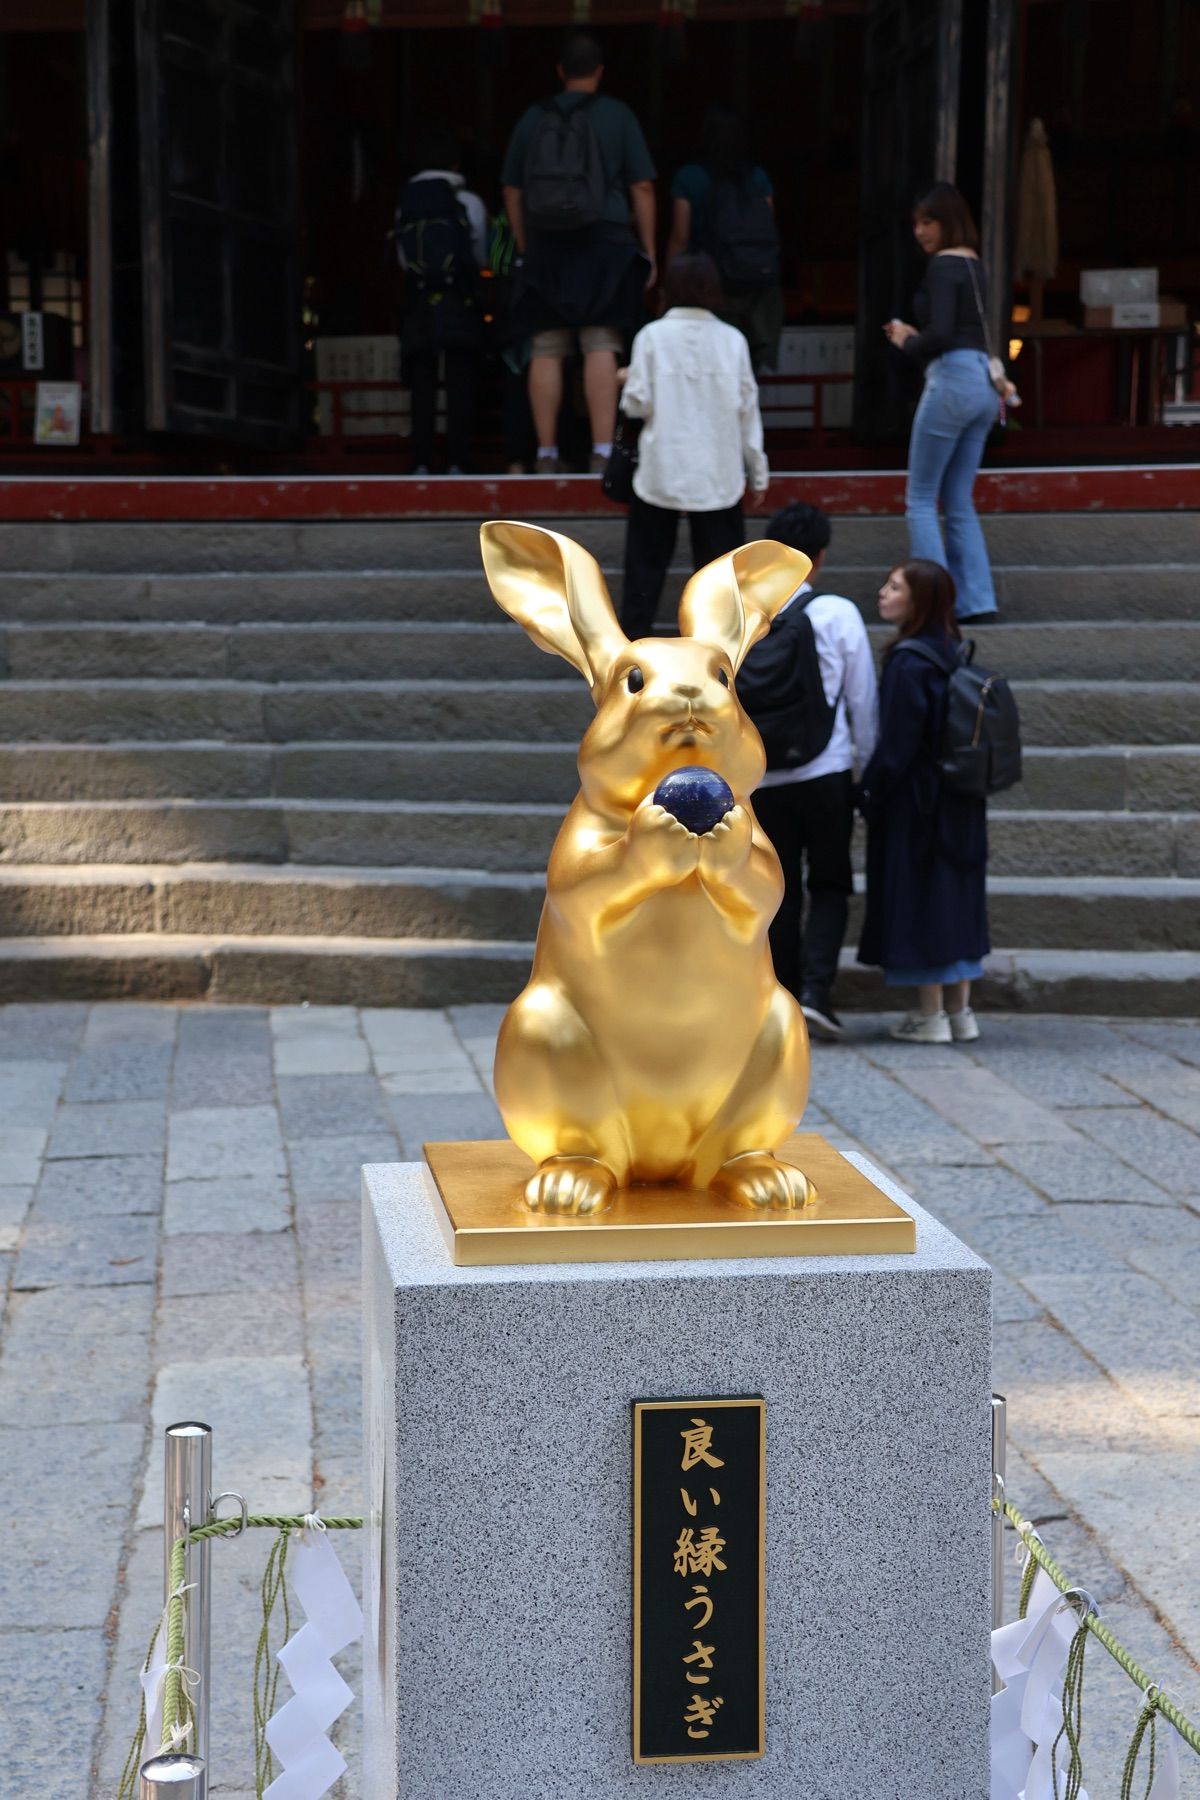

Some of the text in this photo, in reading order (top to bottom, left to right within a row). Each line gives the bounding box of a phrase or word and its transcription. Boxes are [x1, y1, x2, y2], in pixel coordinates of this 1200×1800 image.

[673, 1418, 728, 1739] 良い縁うさぎ
